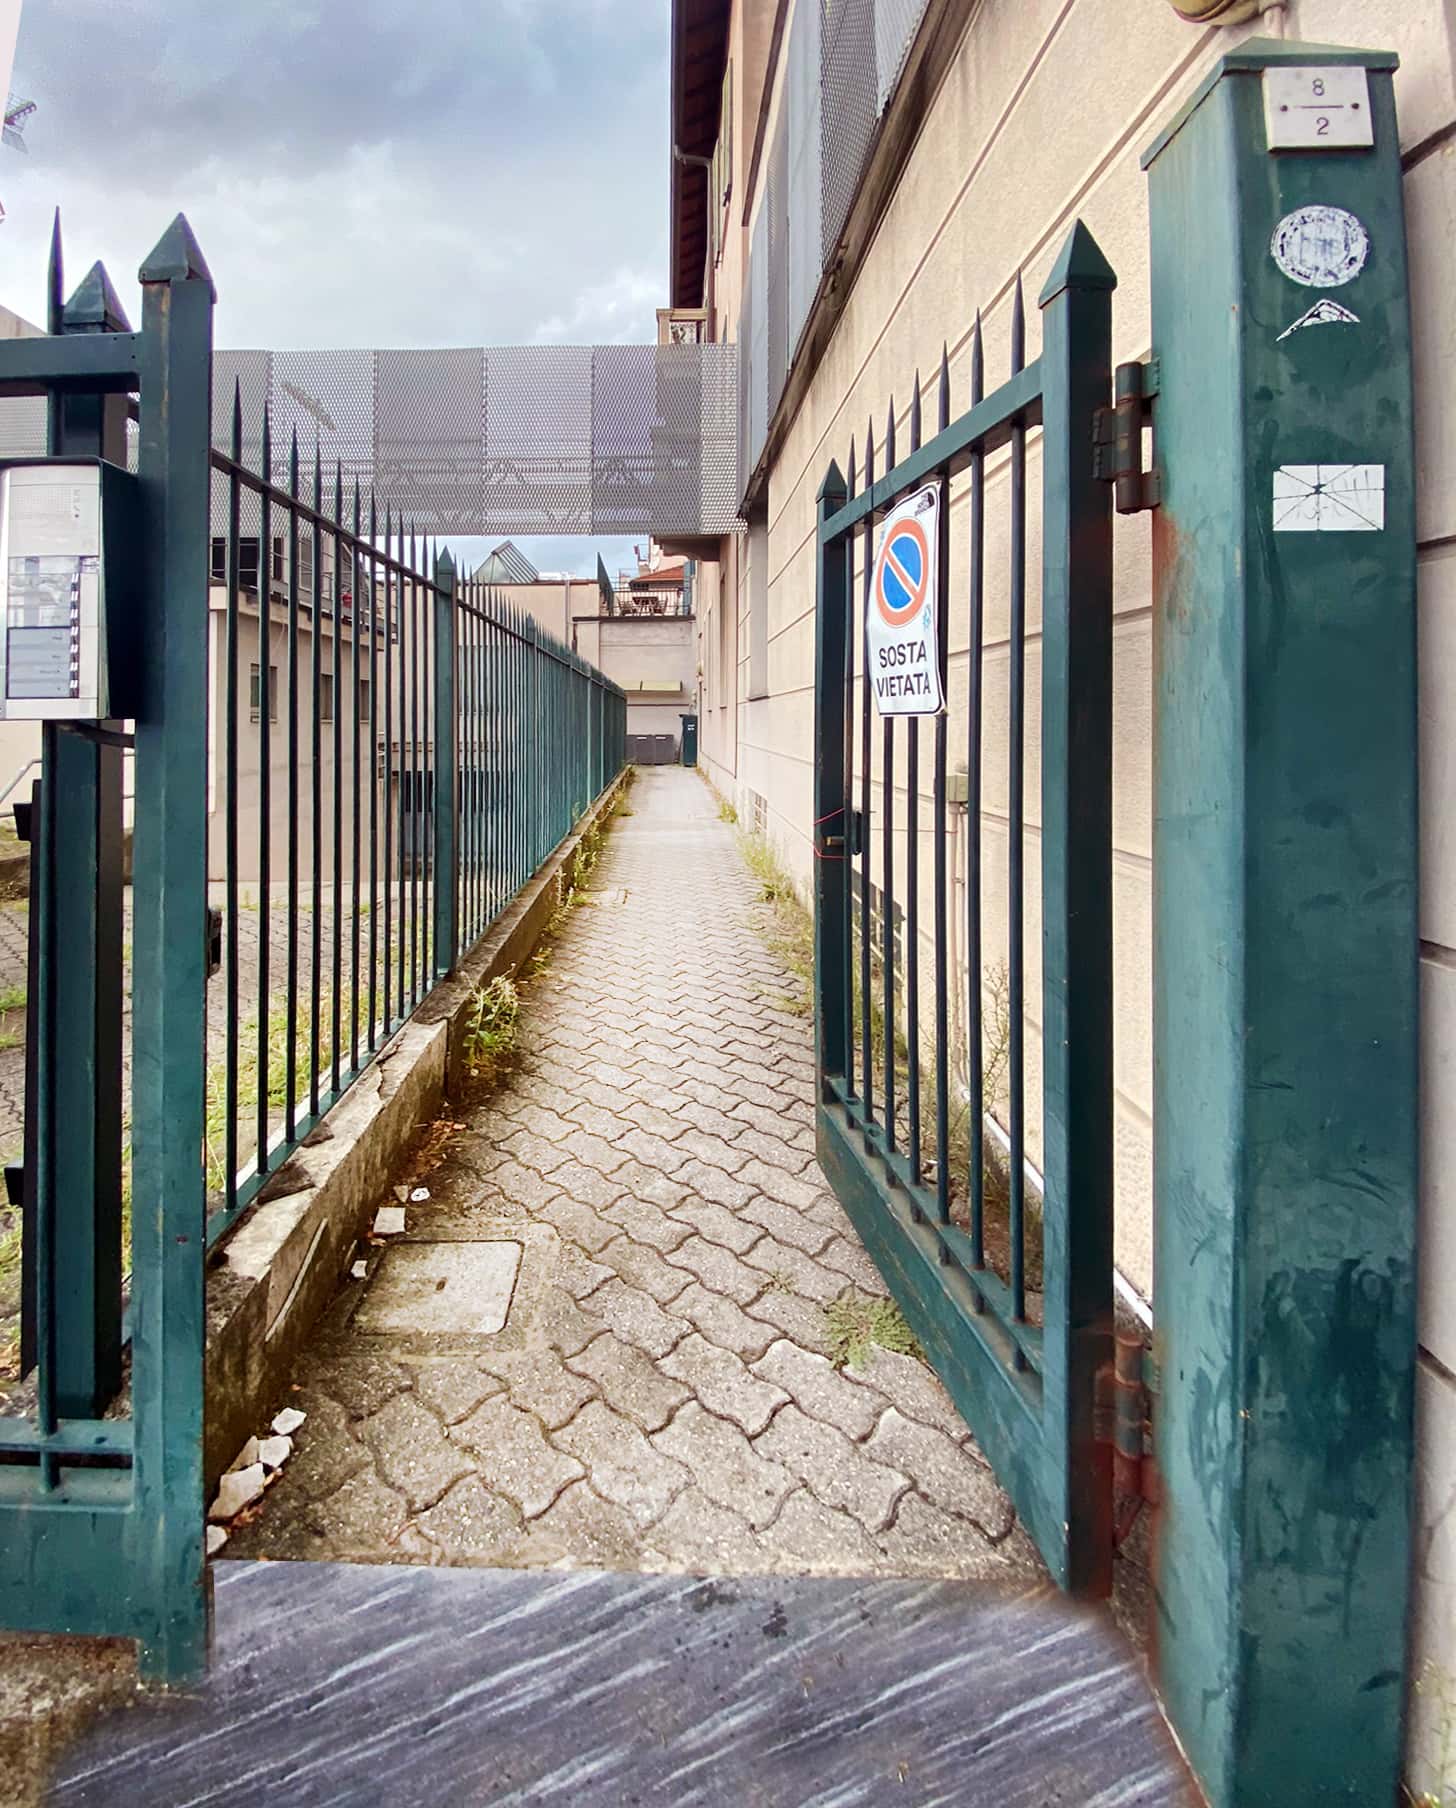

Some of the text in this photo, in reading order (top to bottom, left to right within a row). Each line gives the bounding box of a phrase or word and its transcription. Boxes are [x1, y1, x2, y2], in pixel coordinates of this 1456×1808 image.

[1312, 78, 1325, 97] 8
[1316, 116, 1329, 136] 2
[879, 639, 928, 668] SOSTA
[876, 671, 932, 697] VIETATA
